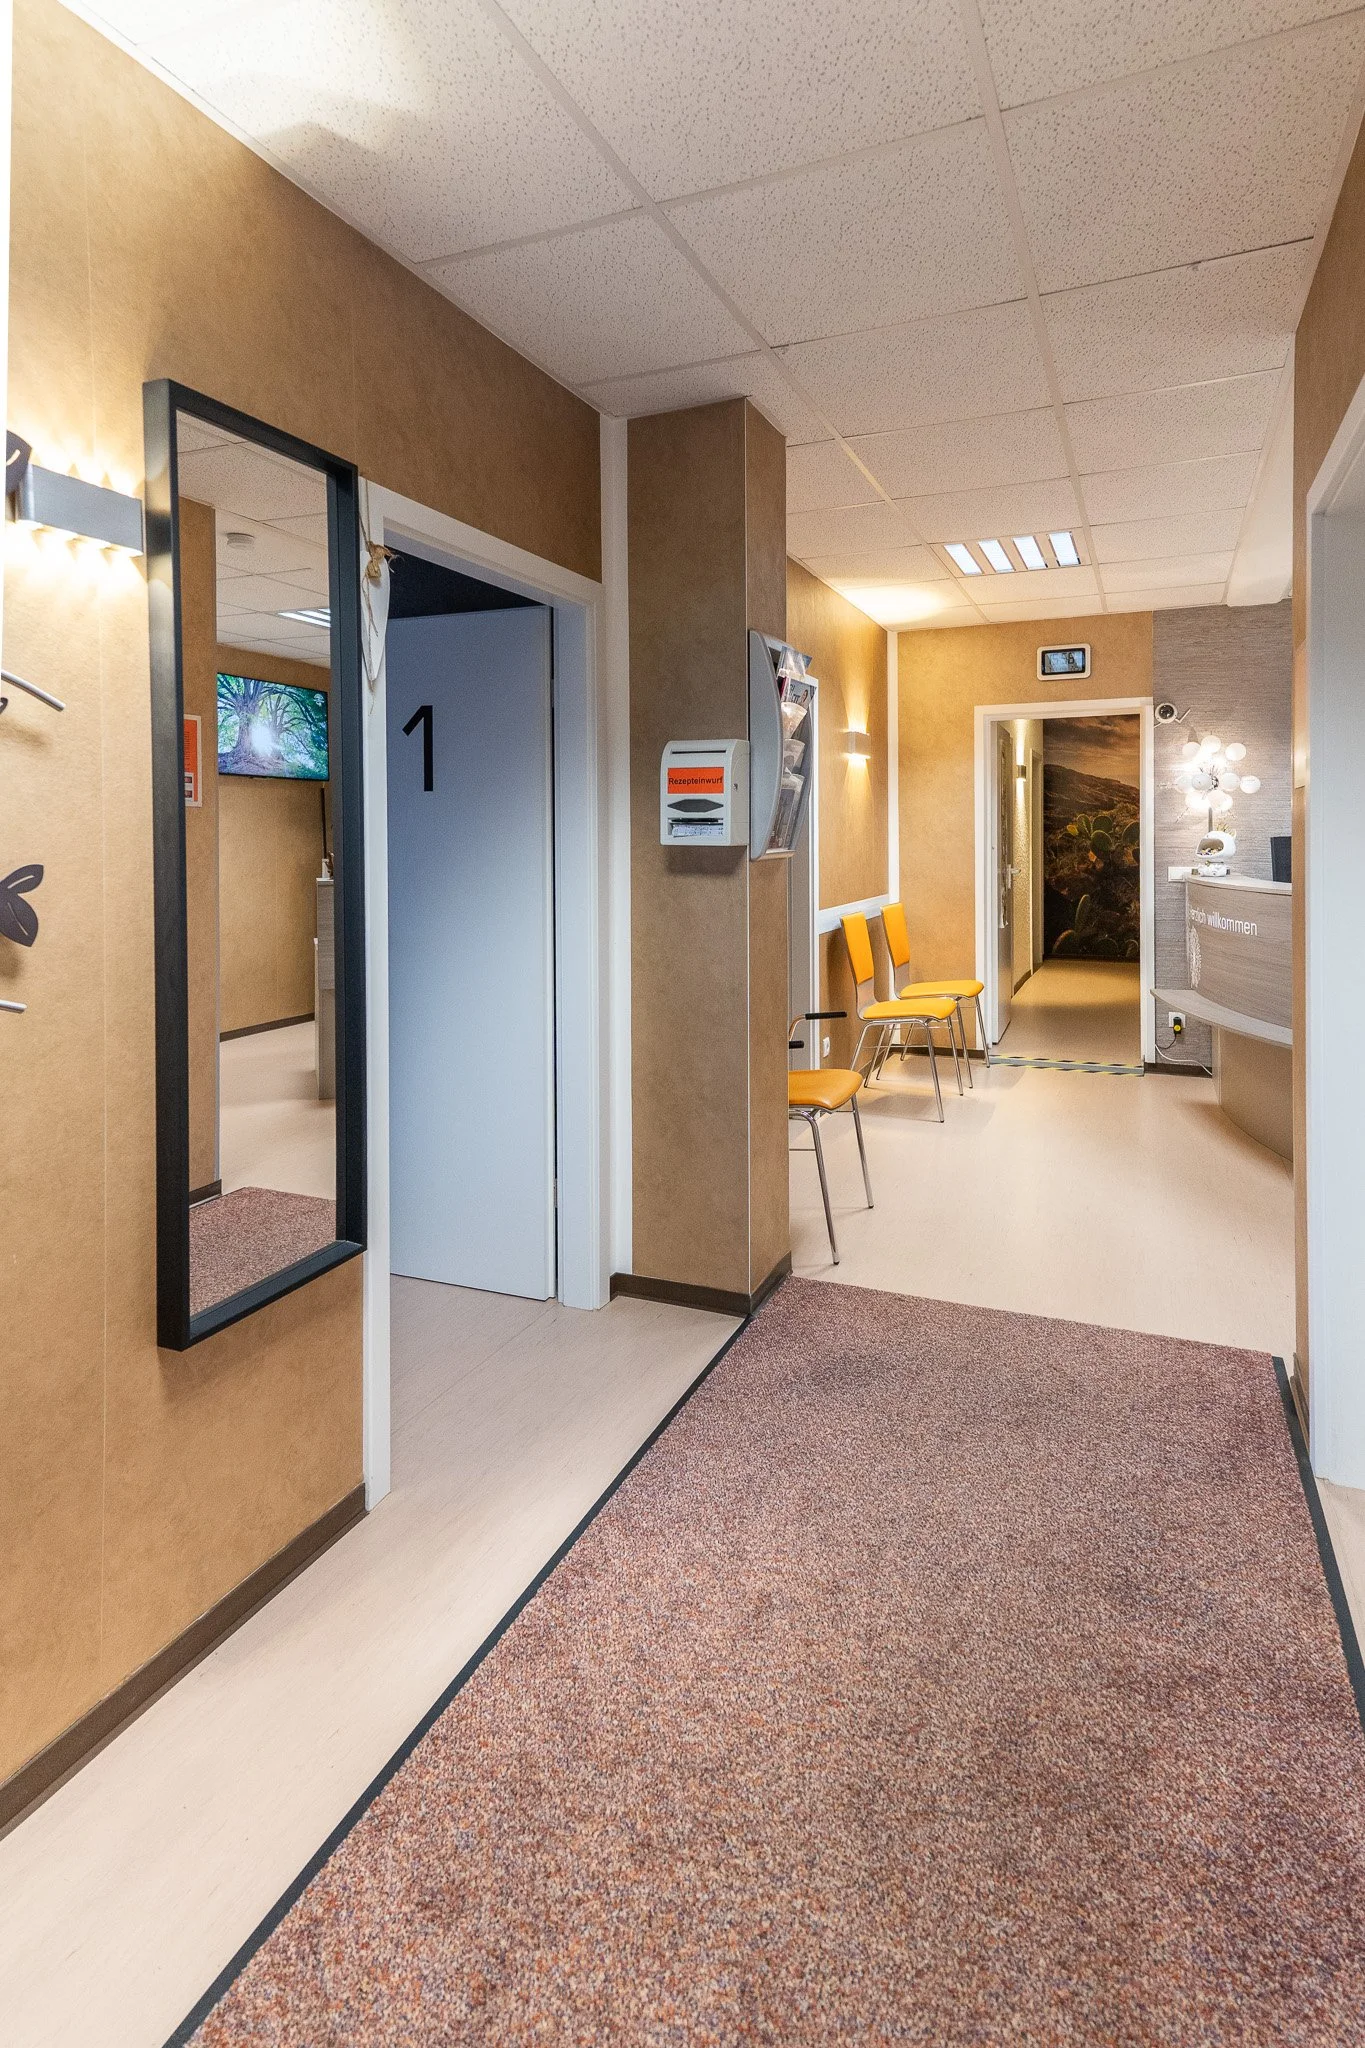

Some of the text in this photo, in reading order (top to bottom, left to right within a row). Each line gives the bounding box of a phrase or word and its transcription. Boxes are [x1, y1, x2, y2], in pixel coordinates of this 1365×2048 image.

[402, 705, 433, 791] 1
[668, 775, 723, 786] Rezepteinwurf
[1207, 911, 1258, 936] willkommen
